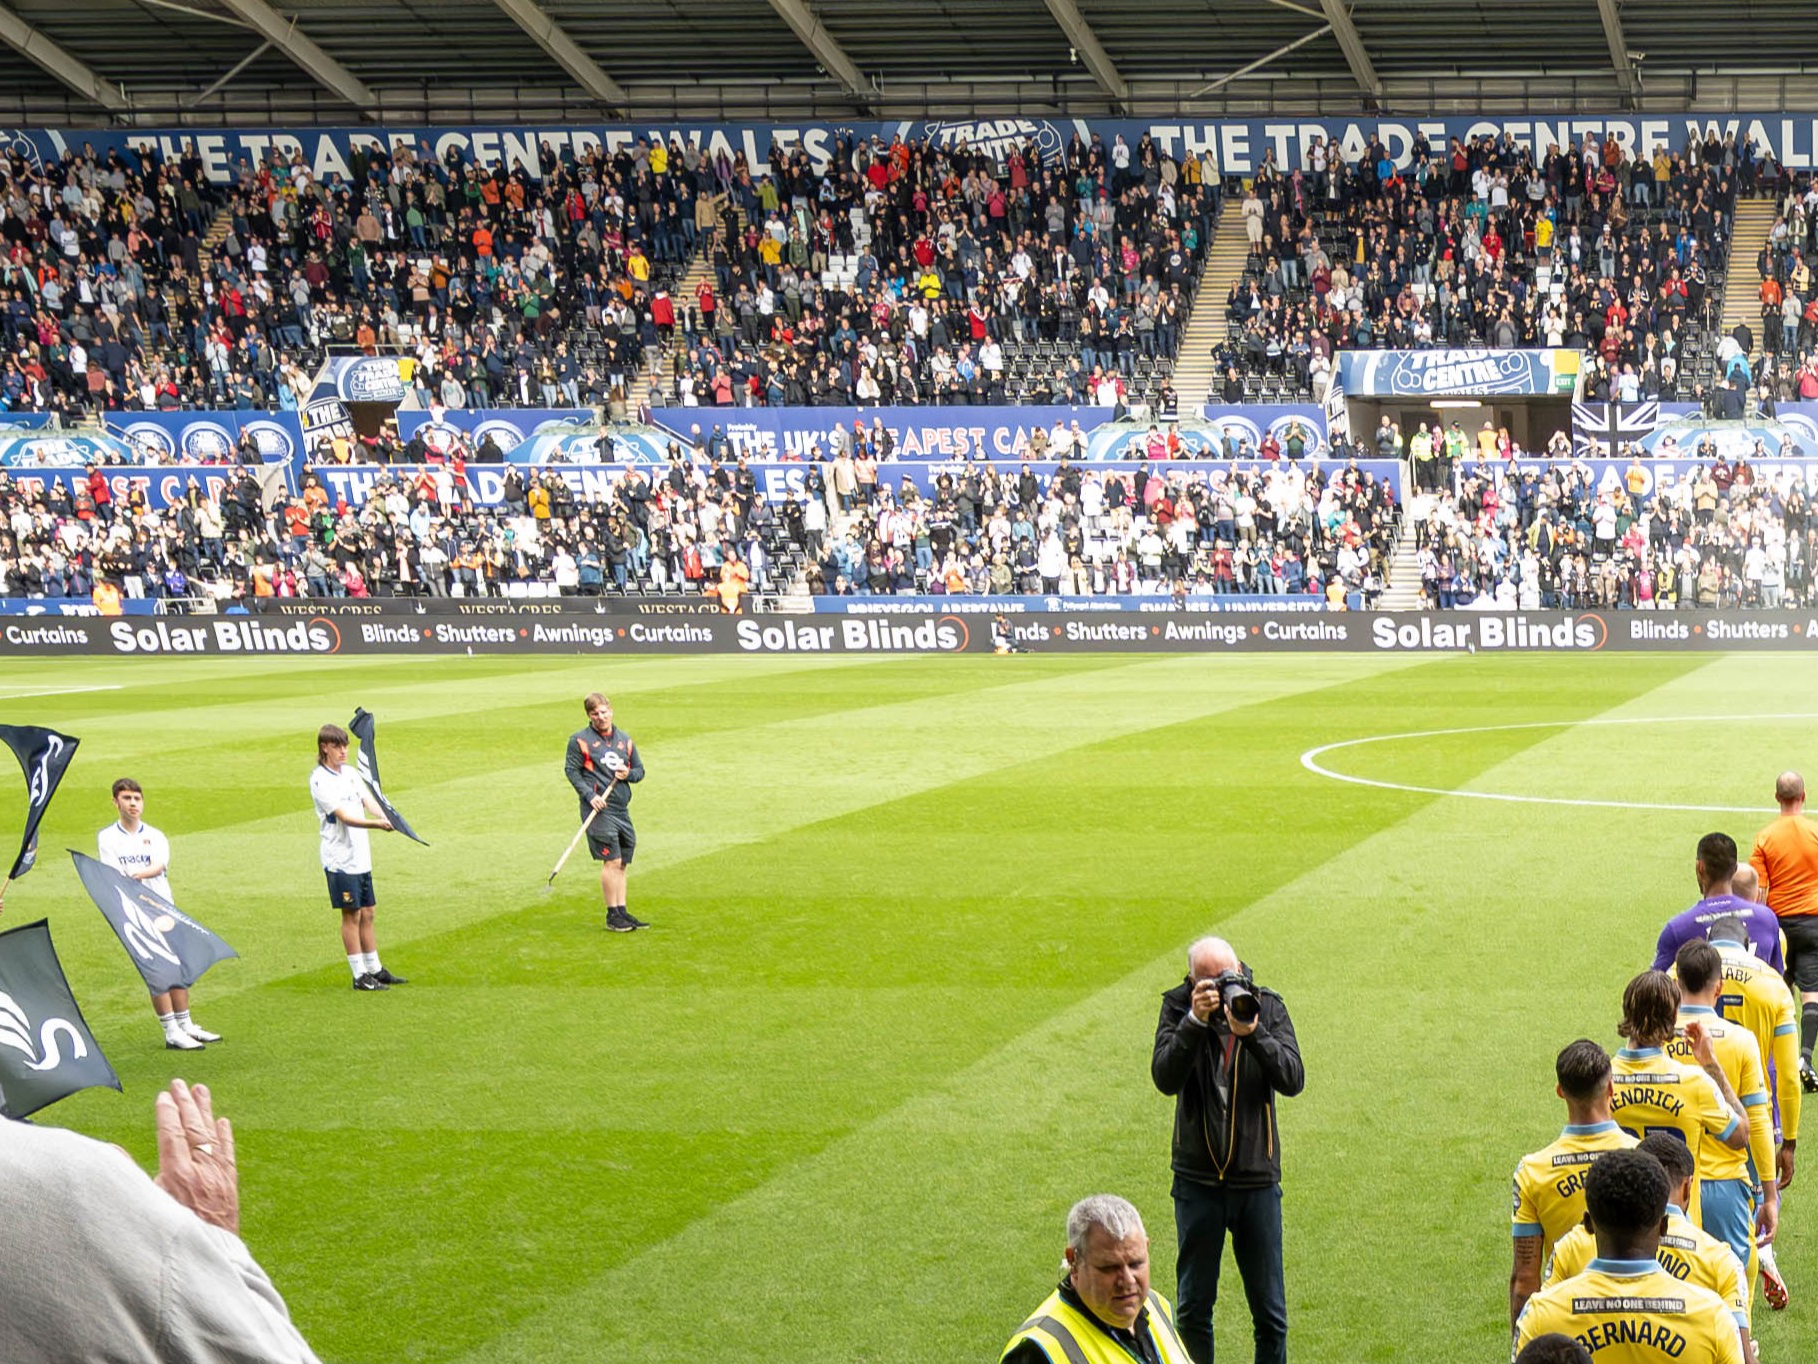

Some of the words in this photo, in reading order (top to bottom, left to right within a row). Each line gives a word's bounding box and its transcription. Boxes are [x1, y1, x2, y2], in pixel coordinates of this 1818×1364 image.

[1148, 126, 1251, 172] THE
[1422, 363, 1501, 387] CENTRE
[1555, 377, 1572, 389] EXIT
[5, 625, 88, 646] Curtains
[109, 621, 206, 653] Solar
[214, 620, 330, 651] Blinds
[361, 622, 420, 644] Blinds
[436, 623, 517, 643] Shutters
[533, 623, 614, 647] Awnings
[629, 623, 714, 643] Curtains
[737, 618, 834, 651] Solar
[842, 618, 958, 650] Blinds
[1066, 620, 1148, 641] Shutters
[1164, 619, 1247, 643] Awnings
[1264, 621, 1348, 641] Curtains
[1372, 616, 1471, 649] Solar
[1480, 615, 1595, 648] Blinds
[1630, 618, 1689, 640] Blinds
[1706, 619, 1788, 640] Shutters
[1574, 1299, 1605, 1311] LEAVE
[1606, 1300, 1622, 1310] NO
[1622, 1299, 1644, 1311] ONE
[1644, 1300, 1684, 1312] BEHIND
